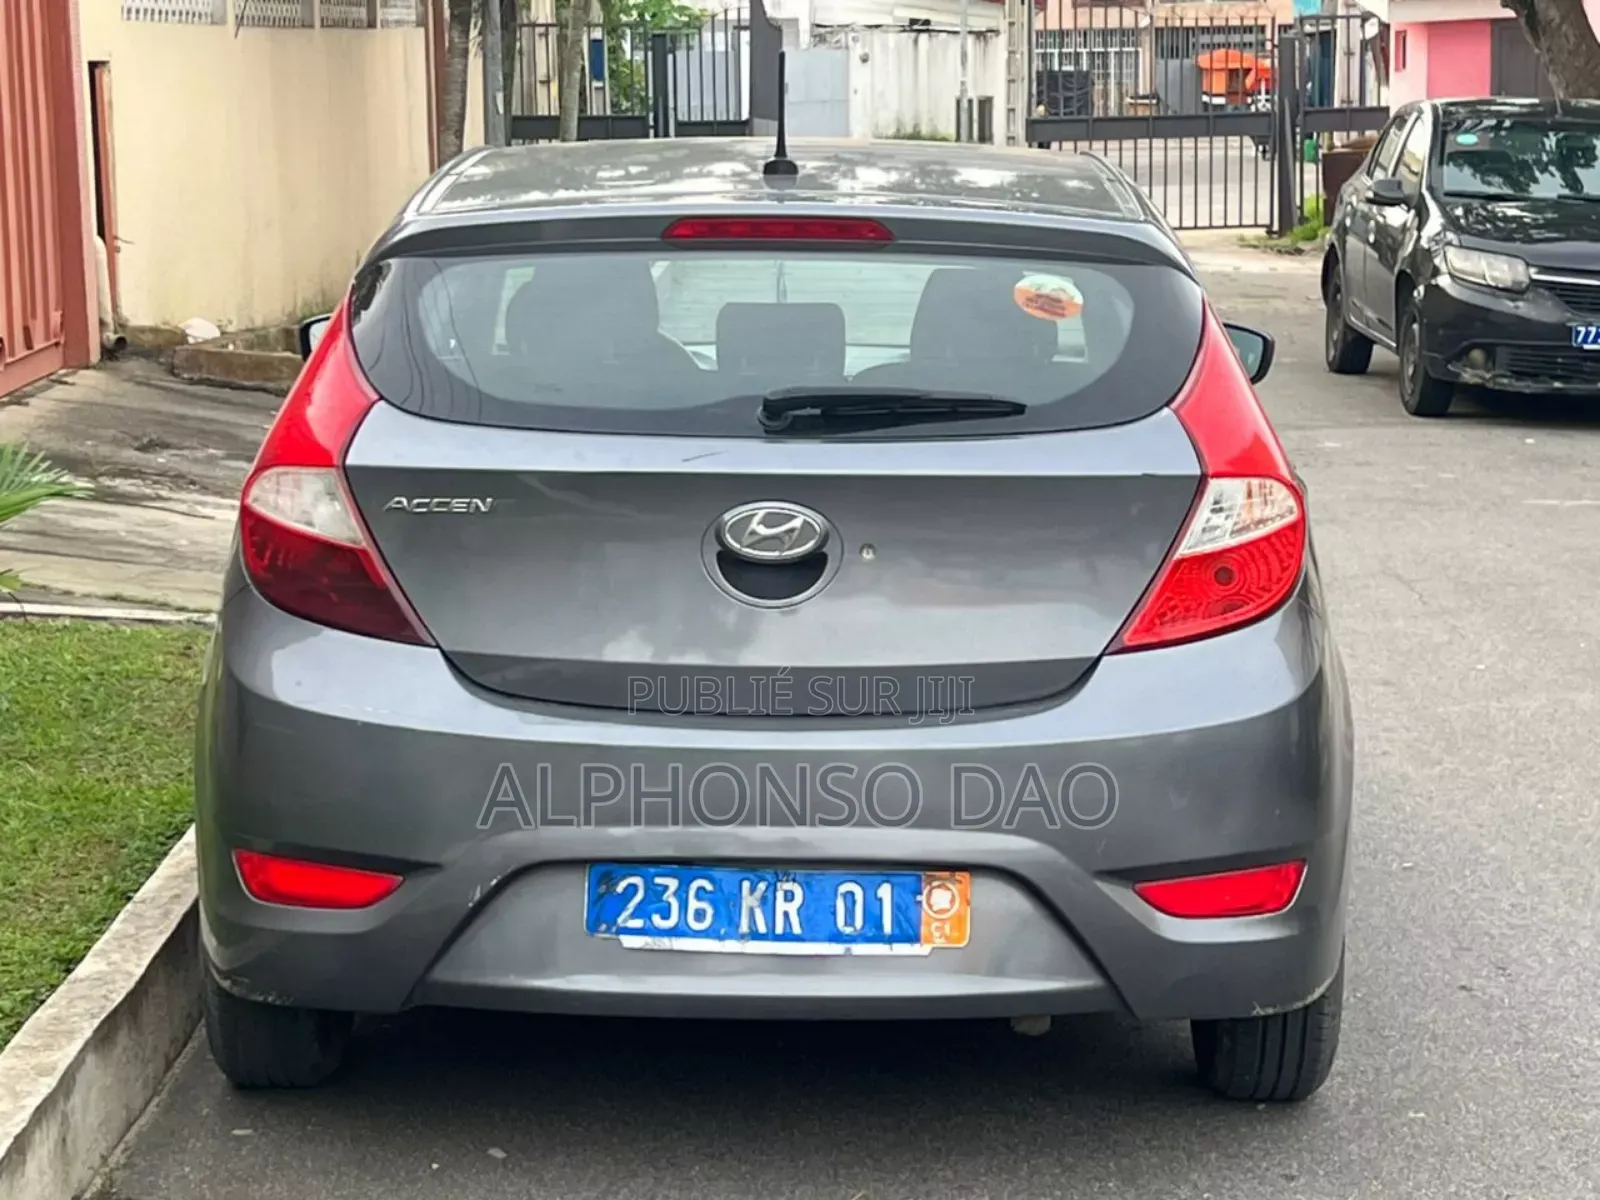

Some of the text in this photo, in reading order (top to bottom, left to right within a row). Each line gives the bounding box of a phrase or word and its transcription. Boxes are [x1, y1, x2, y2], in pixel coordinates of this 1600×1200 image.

[382, 496, 493, 513] ACCEN
[614, 874, 894, 935] 236 KR 01
